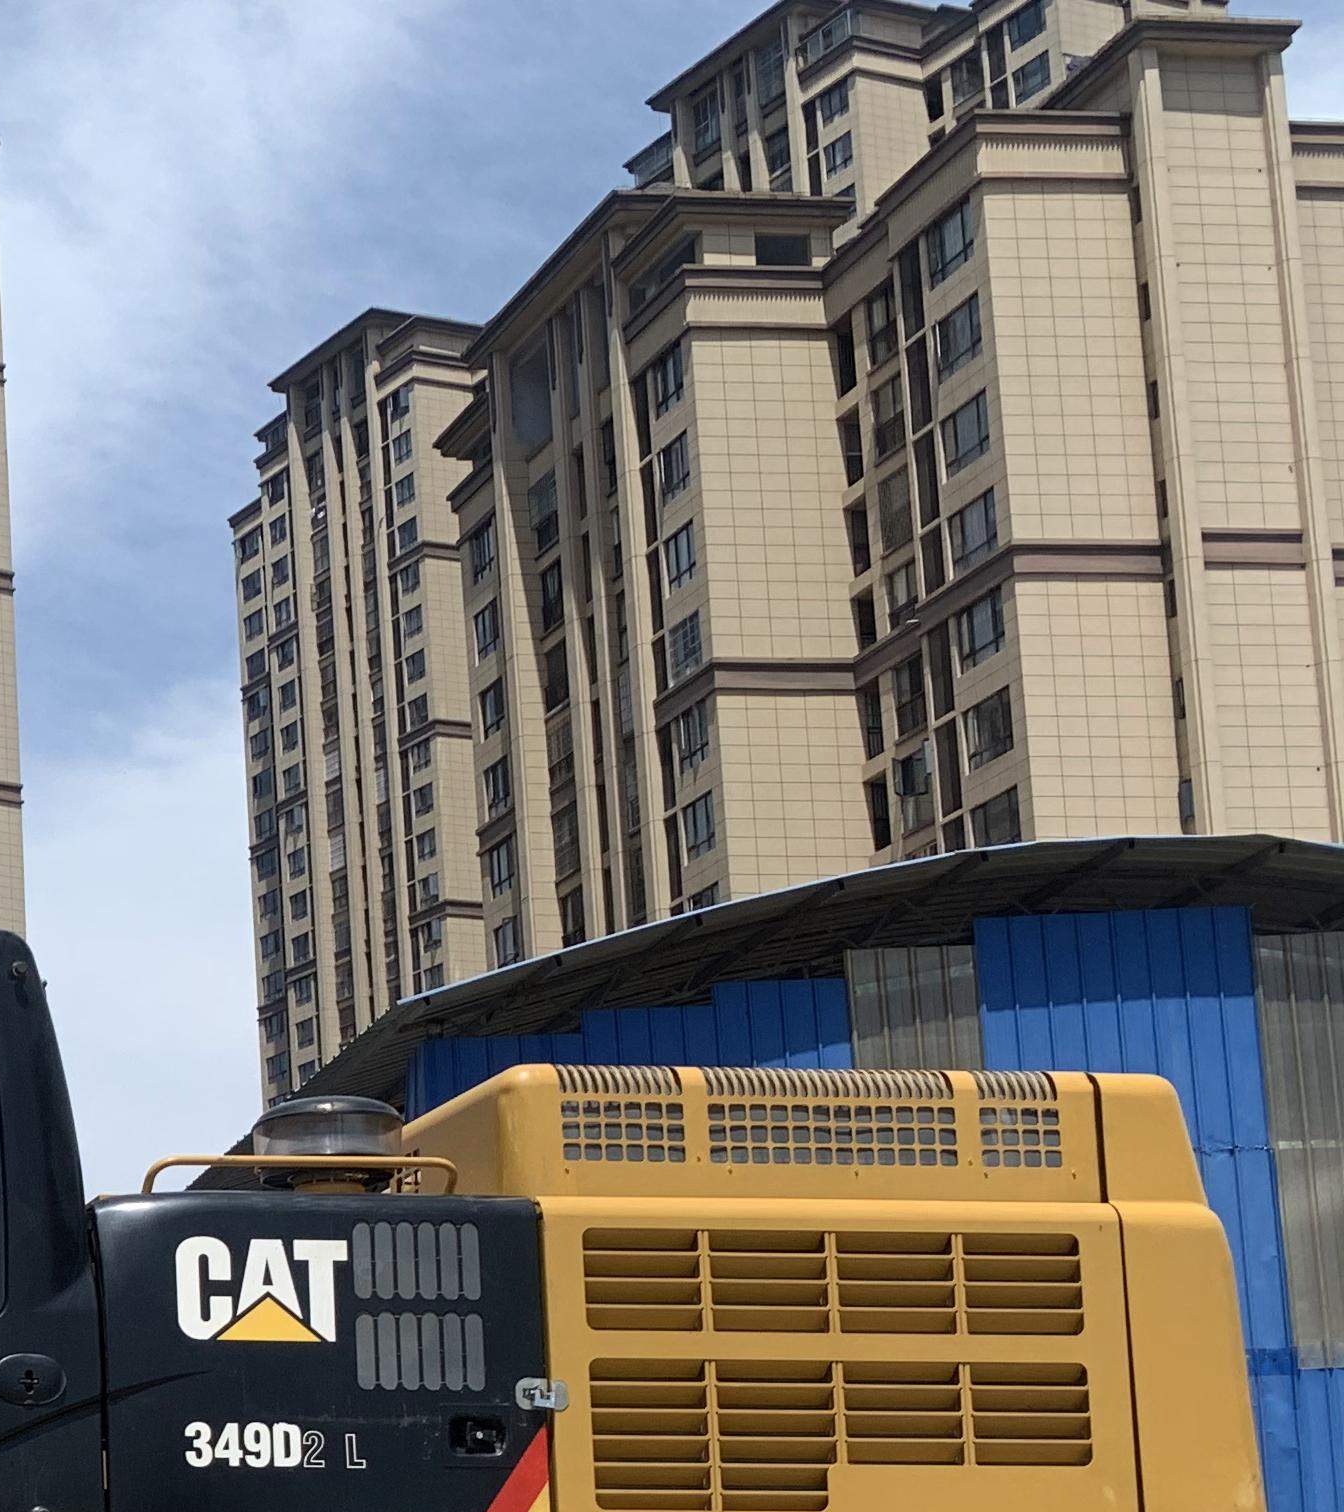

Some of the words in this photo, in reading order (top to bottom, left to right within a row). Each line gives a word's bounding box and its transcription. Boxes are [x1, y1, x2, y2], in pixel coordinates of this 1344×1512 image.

[175, 1236, 348, 1342] CAT
[184, 1422, 326, 1468] 349D2
[345, 1433, 367, 1469] L
